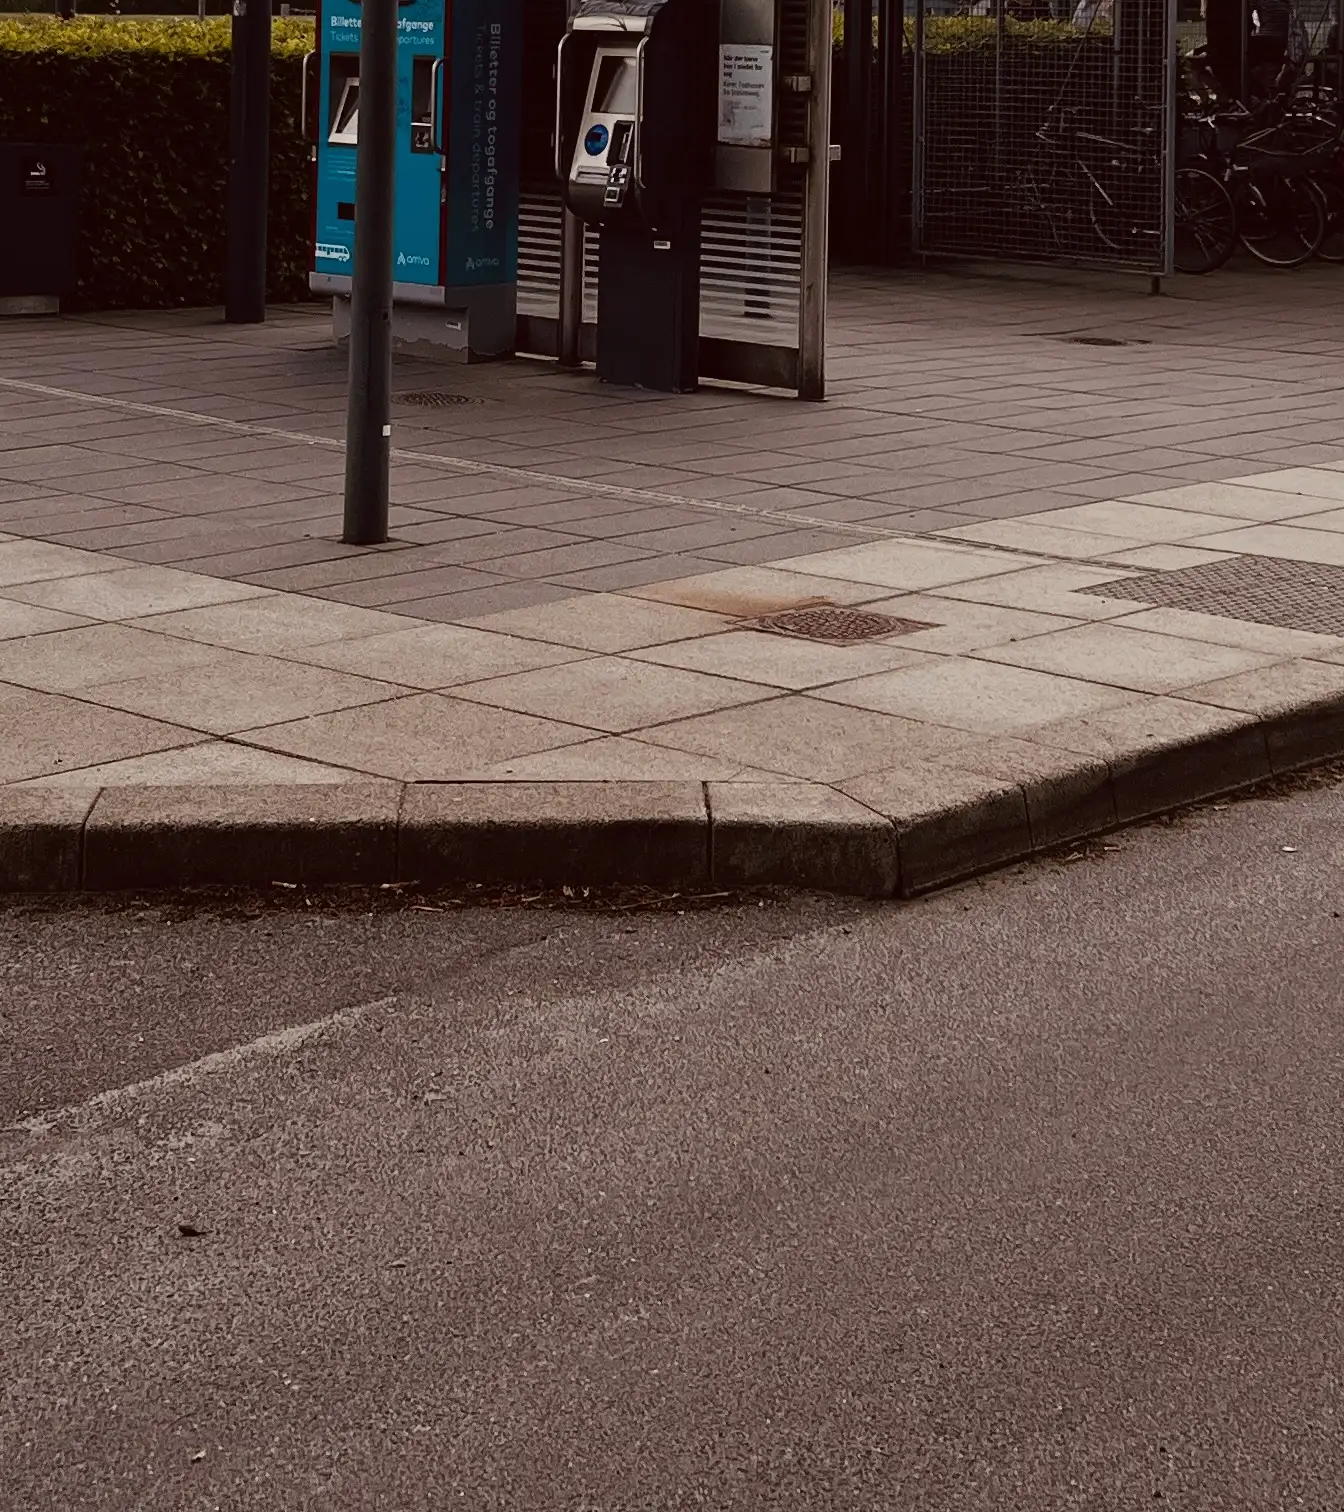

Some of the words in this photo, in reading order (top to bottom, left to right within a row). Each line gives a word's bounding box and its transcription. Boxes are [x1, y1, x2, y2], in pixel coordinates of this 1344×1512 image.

[331, 16, 362, 28] Billette
[331, 31, 358, 43] Tickets
[489, 23, 501, 96] Billetter
[485, 99, 497, 121] og
[484, 126, 499, 230] togafgange
[406, 255, 430, 266] arriva
